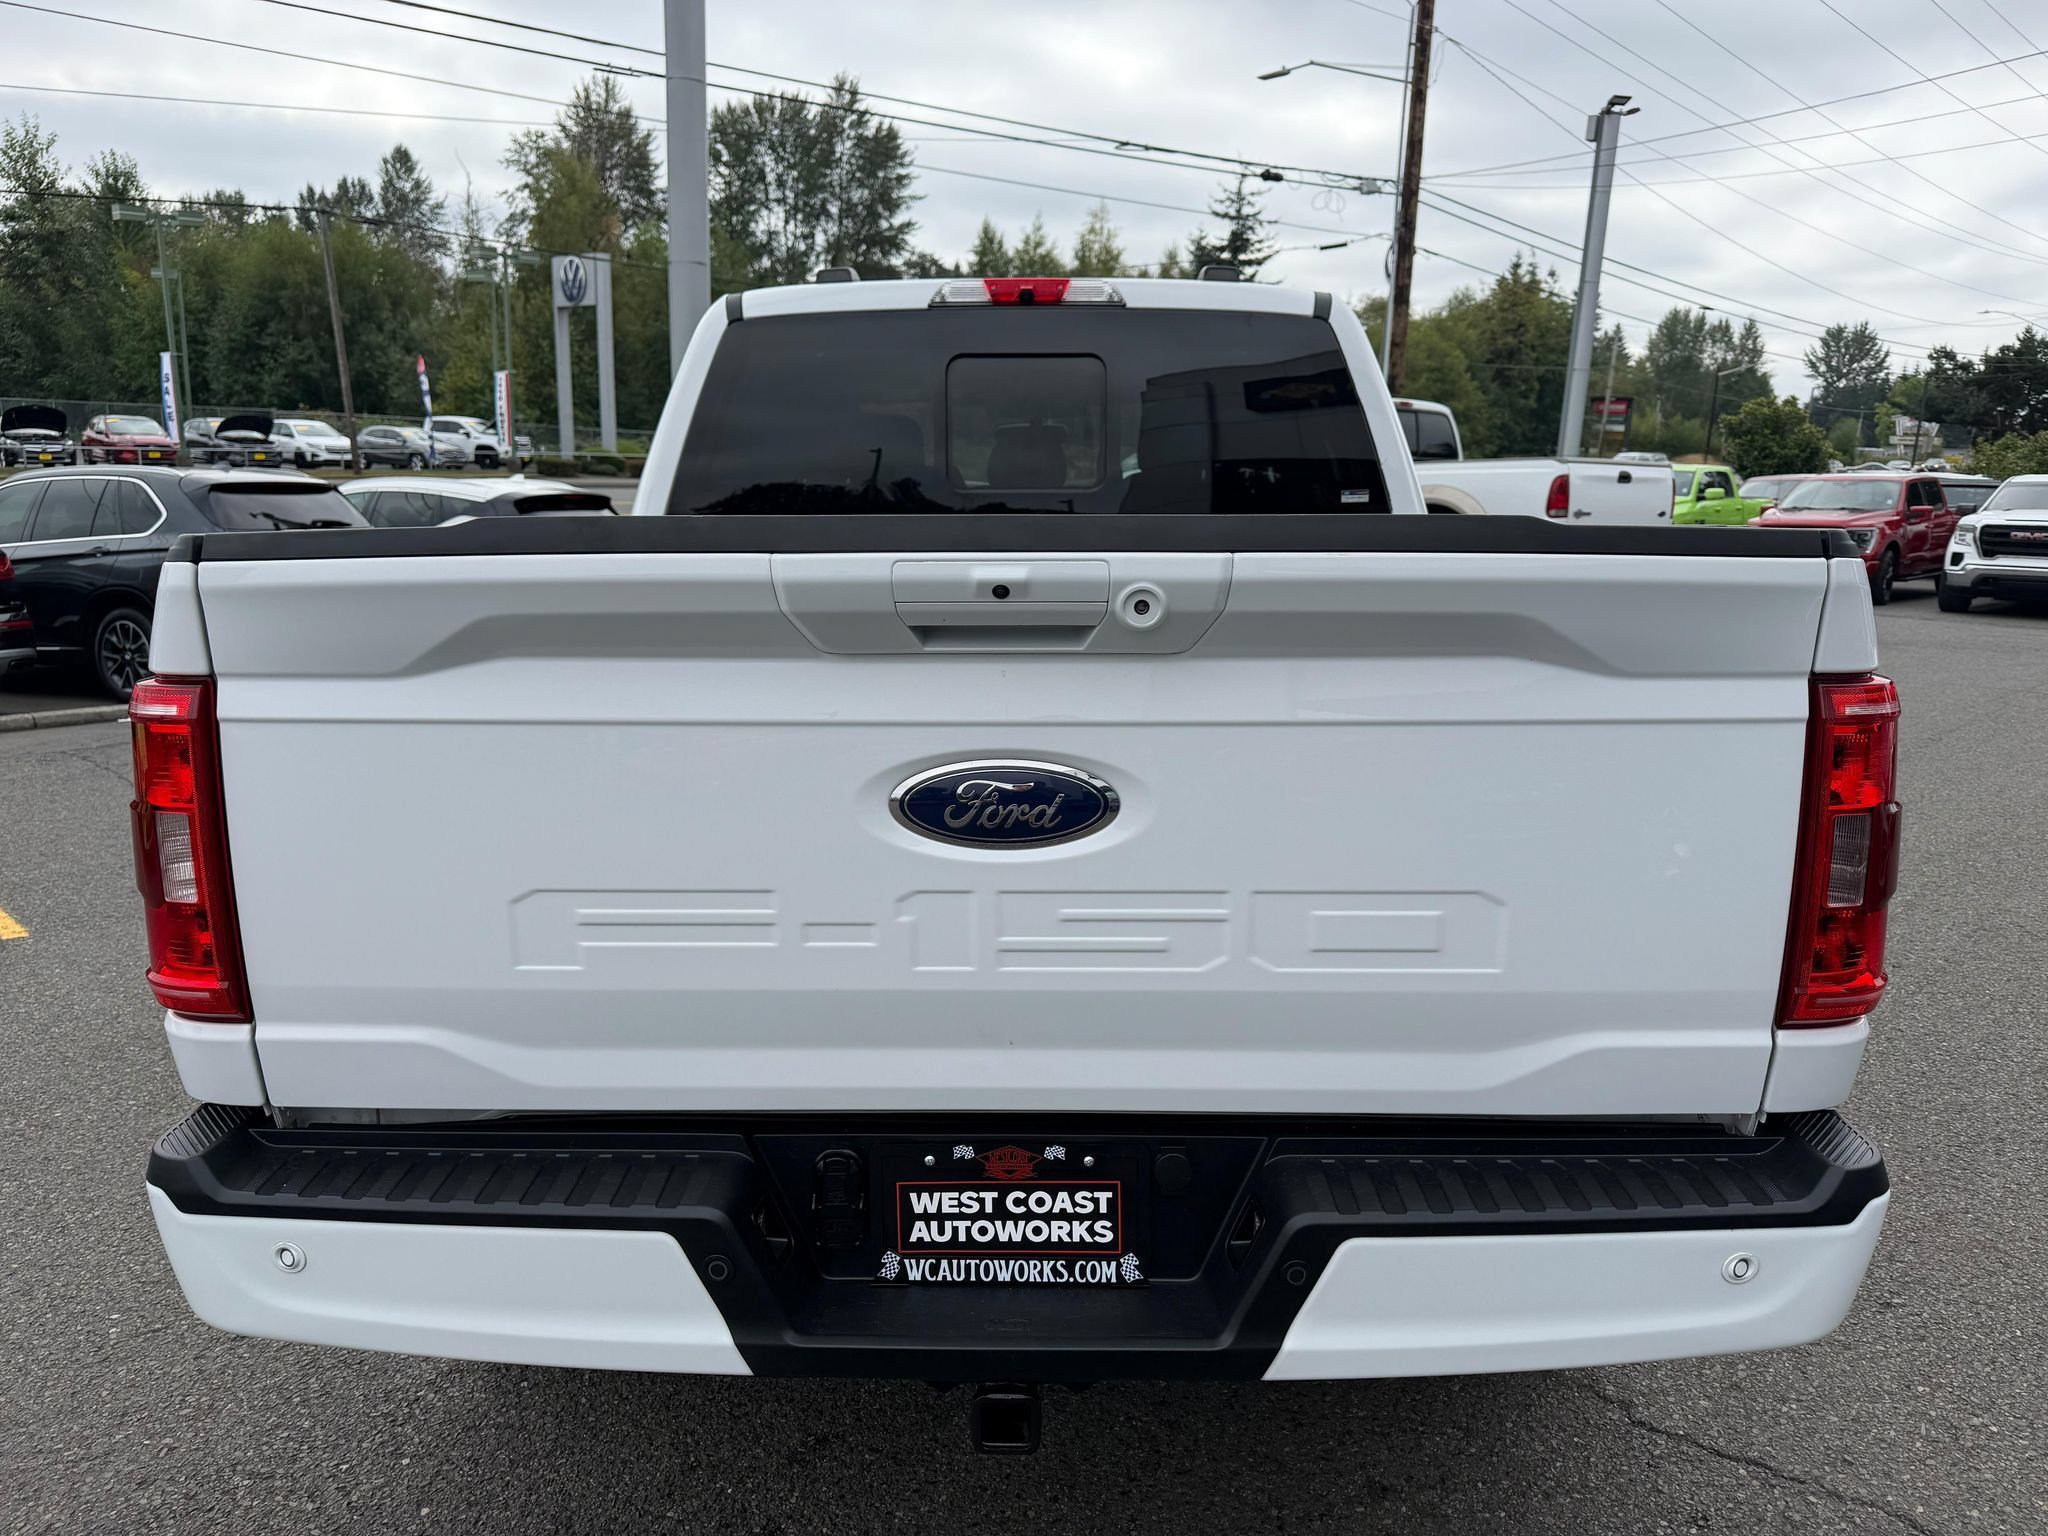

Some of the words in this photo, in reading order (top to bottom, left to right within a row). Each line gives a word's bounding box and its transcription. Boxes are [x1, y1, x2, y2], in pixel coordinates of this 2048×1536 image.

[944, 780, 1065, 829] Ford
[508, 889, 1507, 973] F-150
[909, 1191, 998, 1214] WEST
[1005, 1191, 1113, 1214] COAST
[909, 1220, 1114, 1243] AUTOWORKS
[904, 1258, 1117, 1283] WCAUTOWORKS.COM
